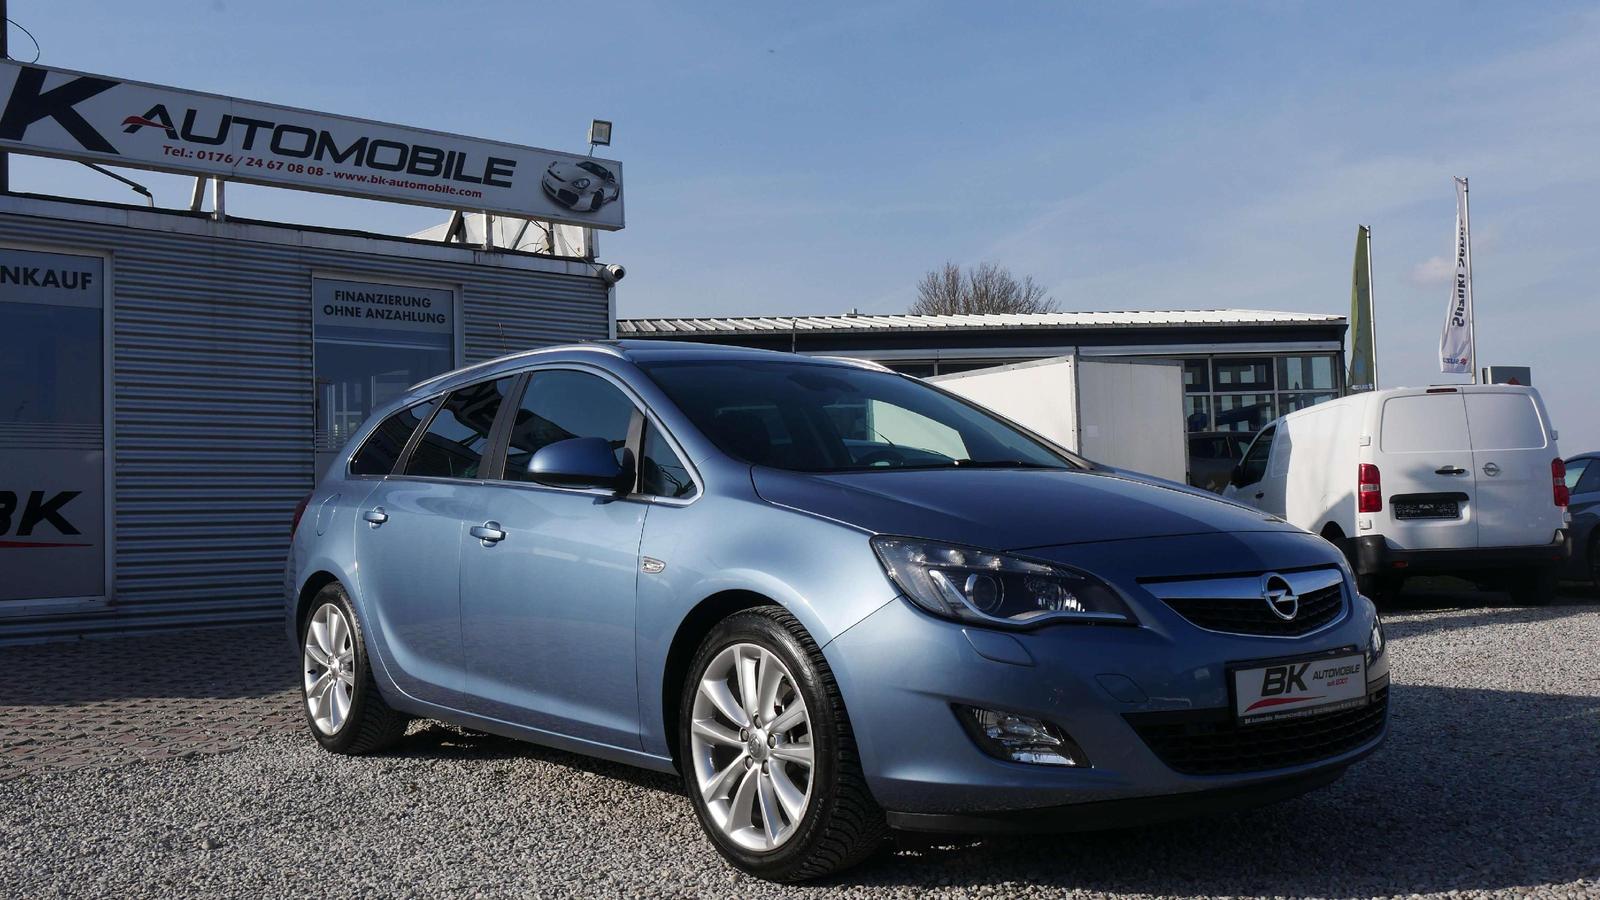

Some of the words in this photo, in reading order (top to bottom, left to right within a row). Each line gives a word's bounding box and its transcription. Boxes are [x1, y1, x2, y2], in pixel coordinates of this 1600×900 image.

[121, 104, 517, 188] AUTOMOBILE
[163, 145, 193, 158] Tel.:
[197, 150, 233, 163] 0176
[245, 156, 264, 168] 24
[266, 160, 285, 171] 67
[287, 163, 304, 174] 08
[307, 167, 324, 177] 08
[333, 171, 483, 199] www.bk-automobile.com
[323, 304, 361, 318] OHNE
[366, 308, 446, 324] ANZAHLUNG
[335, 290, 431, 308] FINANZIERUNG
[1261, 663, 1311, 696] BK
[1312, 664, 1360, 680] AUTOMOBILE
